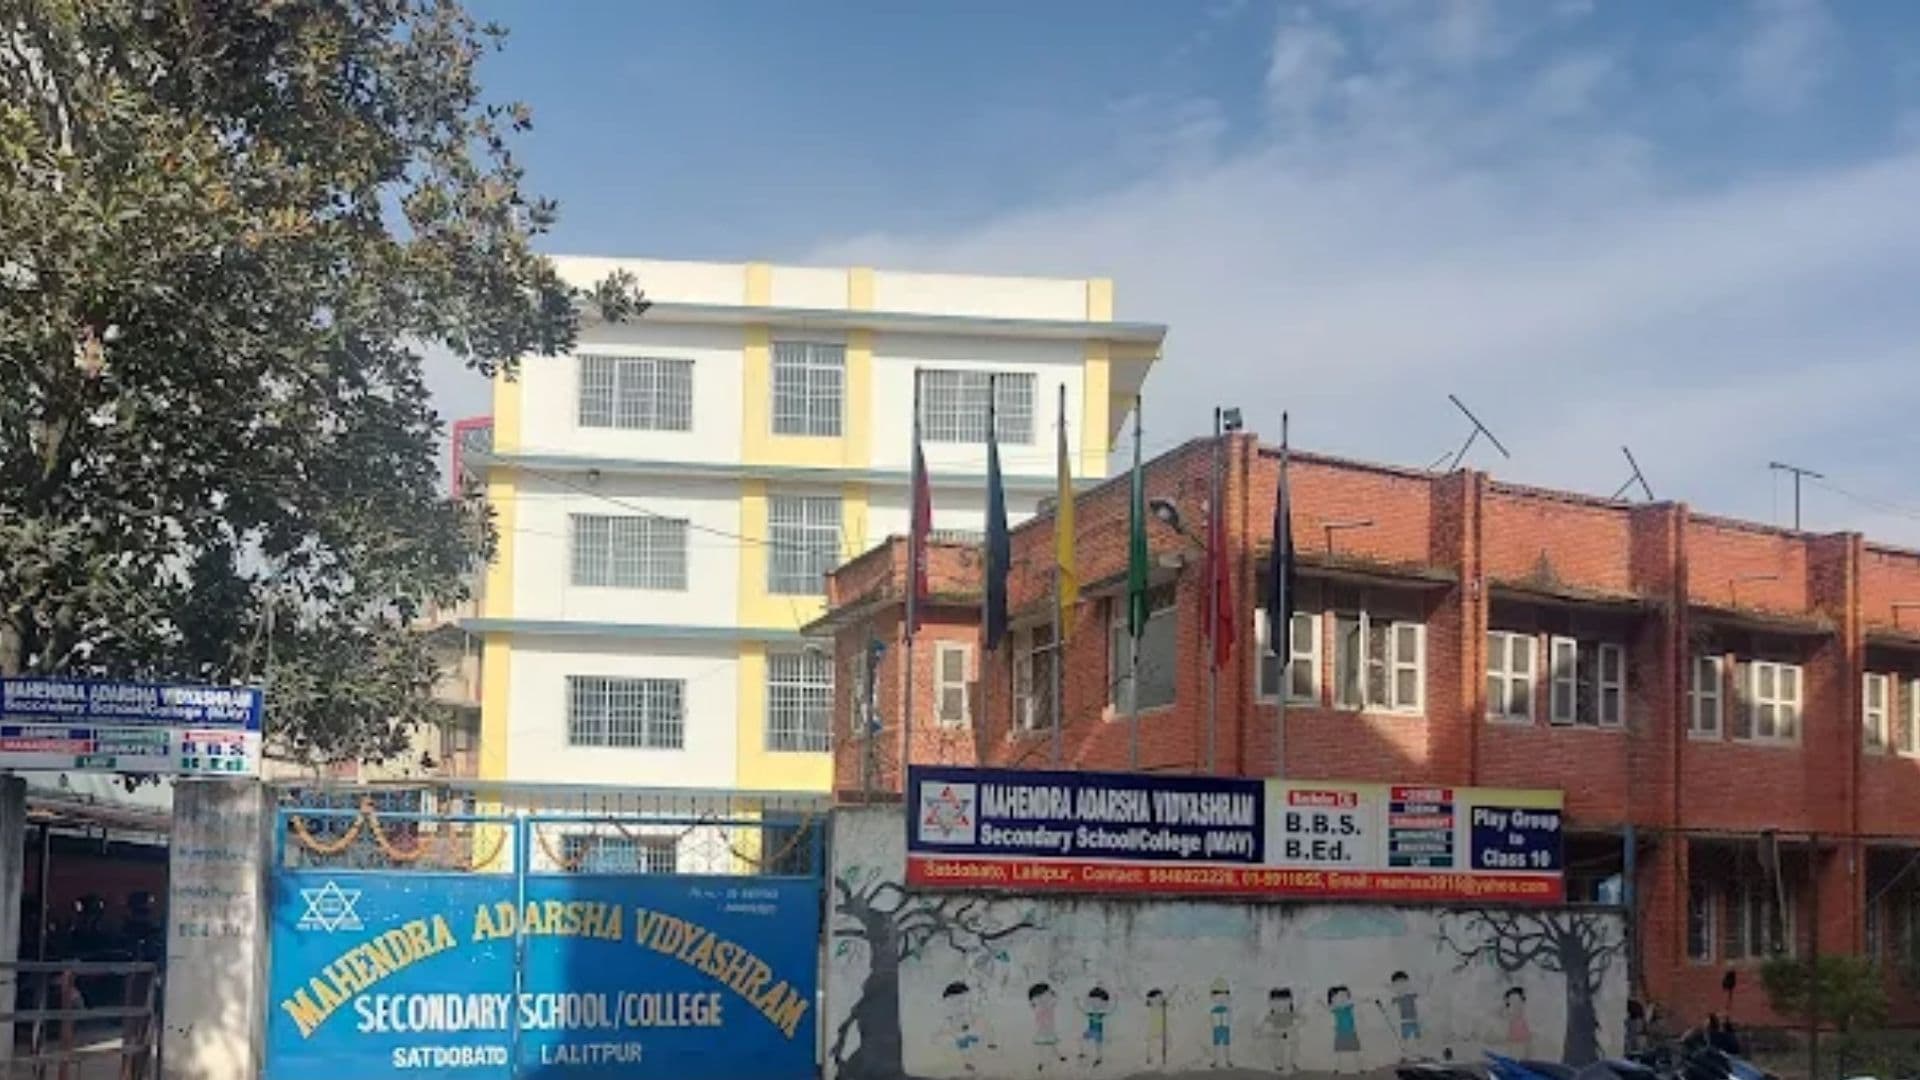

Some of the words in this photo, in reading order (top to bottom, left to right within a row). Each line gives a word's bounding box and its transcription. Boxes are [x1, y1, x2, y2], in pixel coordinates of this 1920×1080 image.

[981, 783, 1072, 820] MAHENDRA
[1075, 787, 1150, 823] ADARSHA
[1153, 790, 1255, 826] VIDYASHRAM
[1286, 812, 1361, 835] B.B.S.
[1474, 809, 1507, 831] Play
[1512, 810, 1560, 833] Group
[981, 823, 1073, 852] Secondary
[1077, 826, 1200, 857] School/College
[1206, 833, 1255, 857] (MAV)
[1286, 839, 1352, 861] B.Ed.
[1509, 833, 1526, 845] to
[1481, 849, 1527, 867] Class
[1530, 850, 1551, 868] 10
[282, 914, 456, 1039] MAHENDRA
[473, 901, 622, 942] ADARSHA
[636, 908, 810, 1039] VIDYASHRAM
[356, 993, 512, 1034] SECONDARY
[392, 1046, 508, 1068] SATDOBATO
[541, 1044, 643, 1065] LALITPUR
